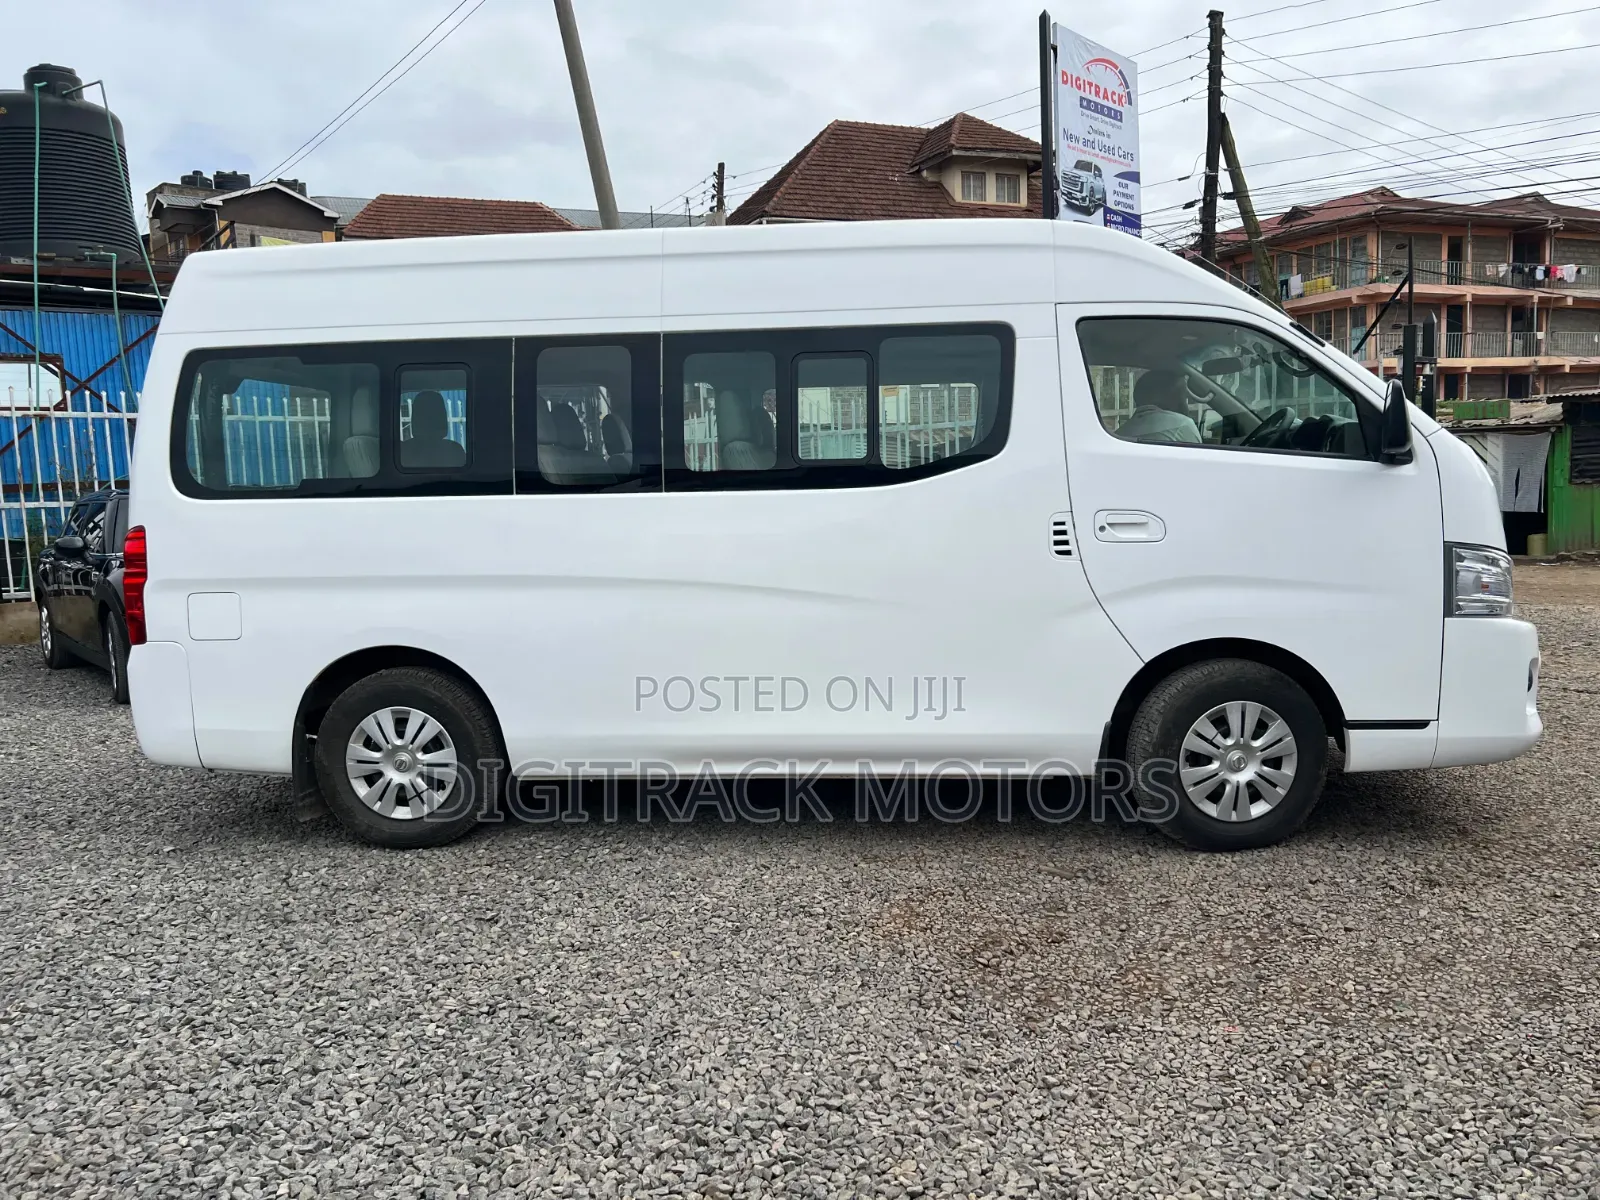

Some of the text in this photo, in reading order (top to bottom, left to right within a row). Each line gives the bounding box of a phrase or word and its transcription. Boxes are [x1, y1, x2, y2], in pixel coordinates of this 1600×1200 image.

[1061, 69, 1124, 107] DIGITRACK
[1082, 99, 1121, 120] MOTORS
[1063, 128, 1081, 146] New
[1082, 137, 1095, 150] and
[1097, 140, 1116, 157] Used
[1117, 146, 1134, 162] Cars
[1118, 181, 1129, 190] OUR
[1112, 189, 1135, 201] PAYMENT
[1113, 199, 1135, 211] OPTIONS
[1110, 213, 1123, 222] CASH
